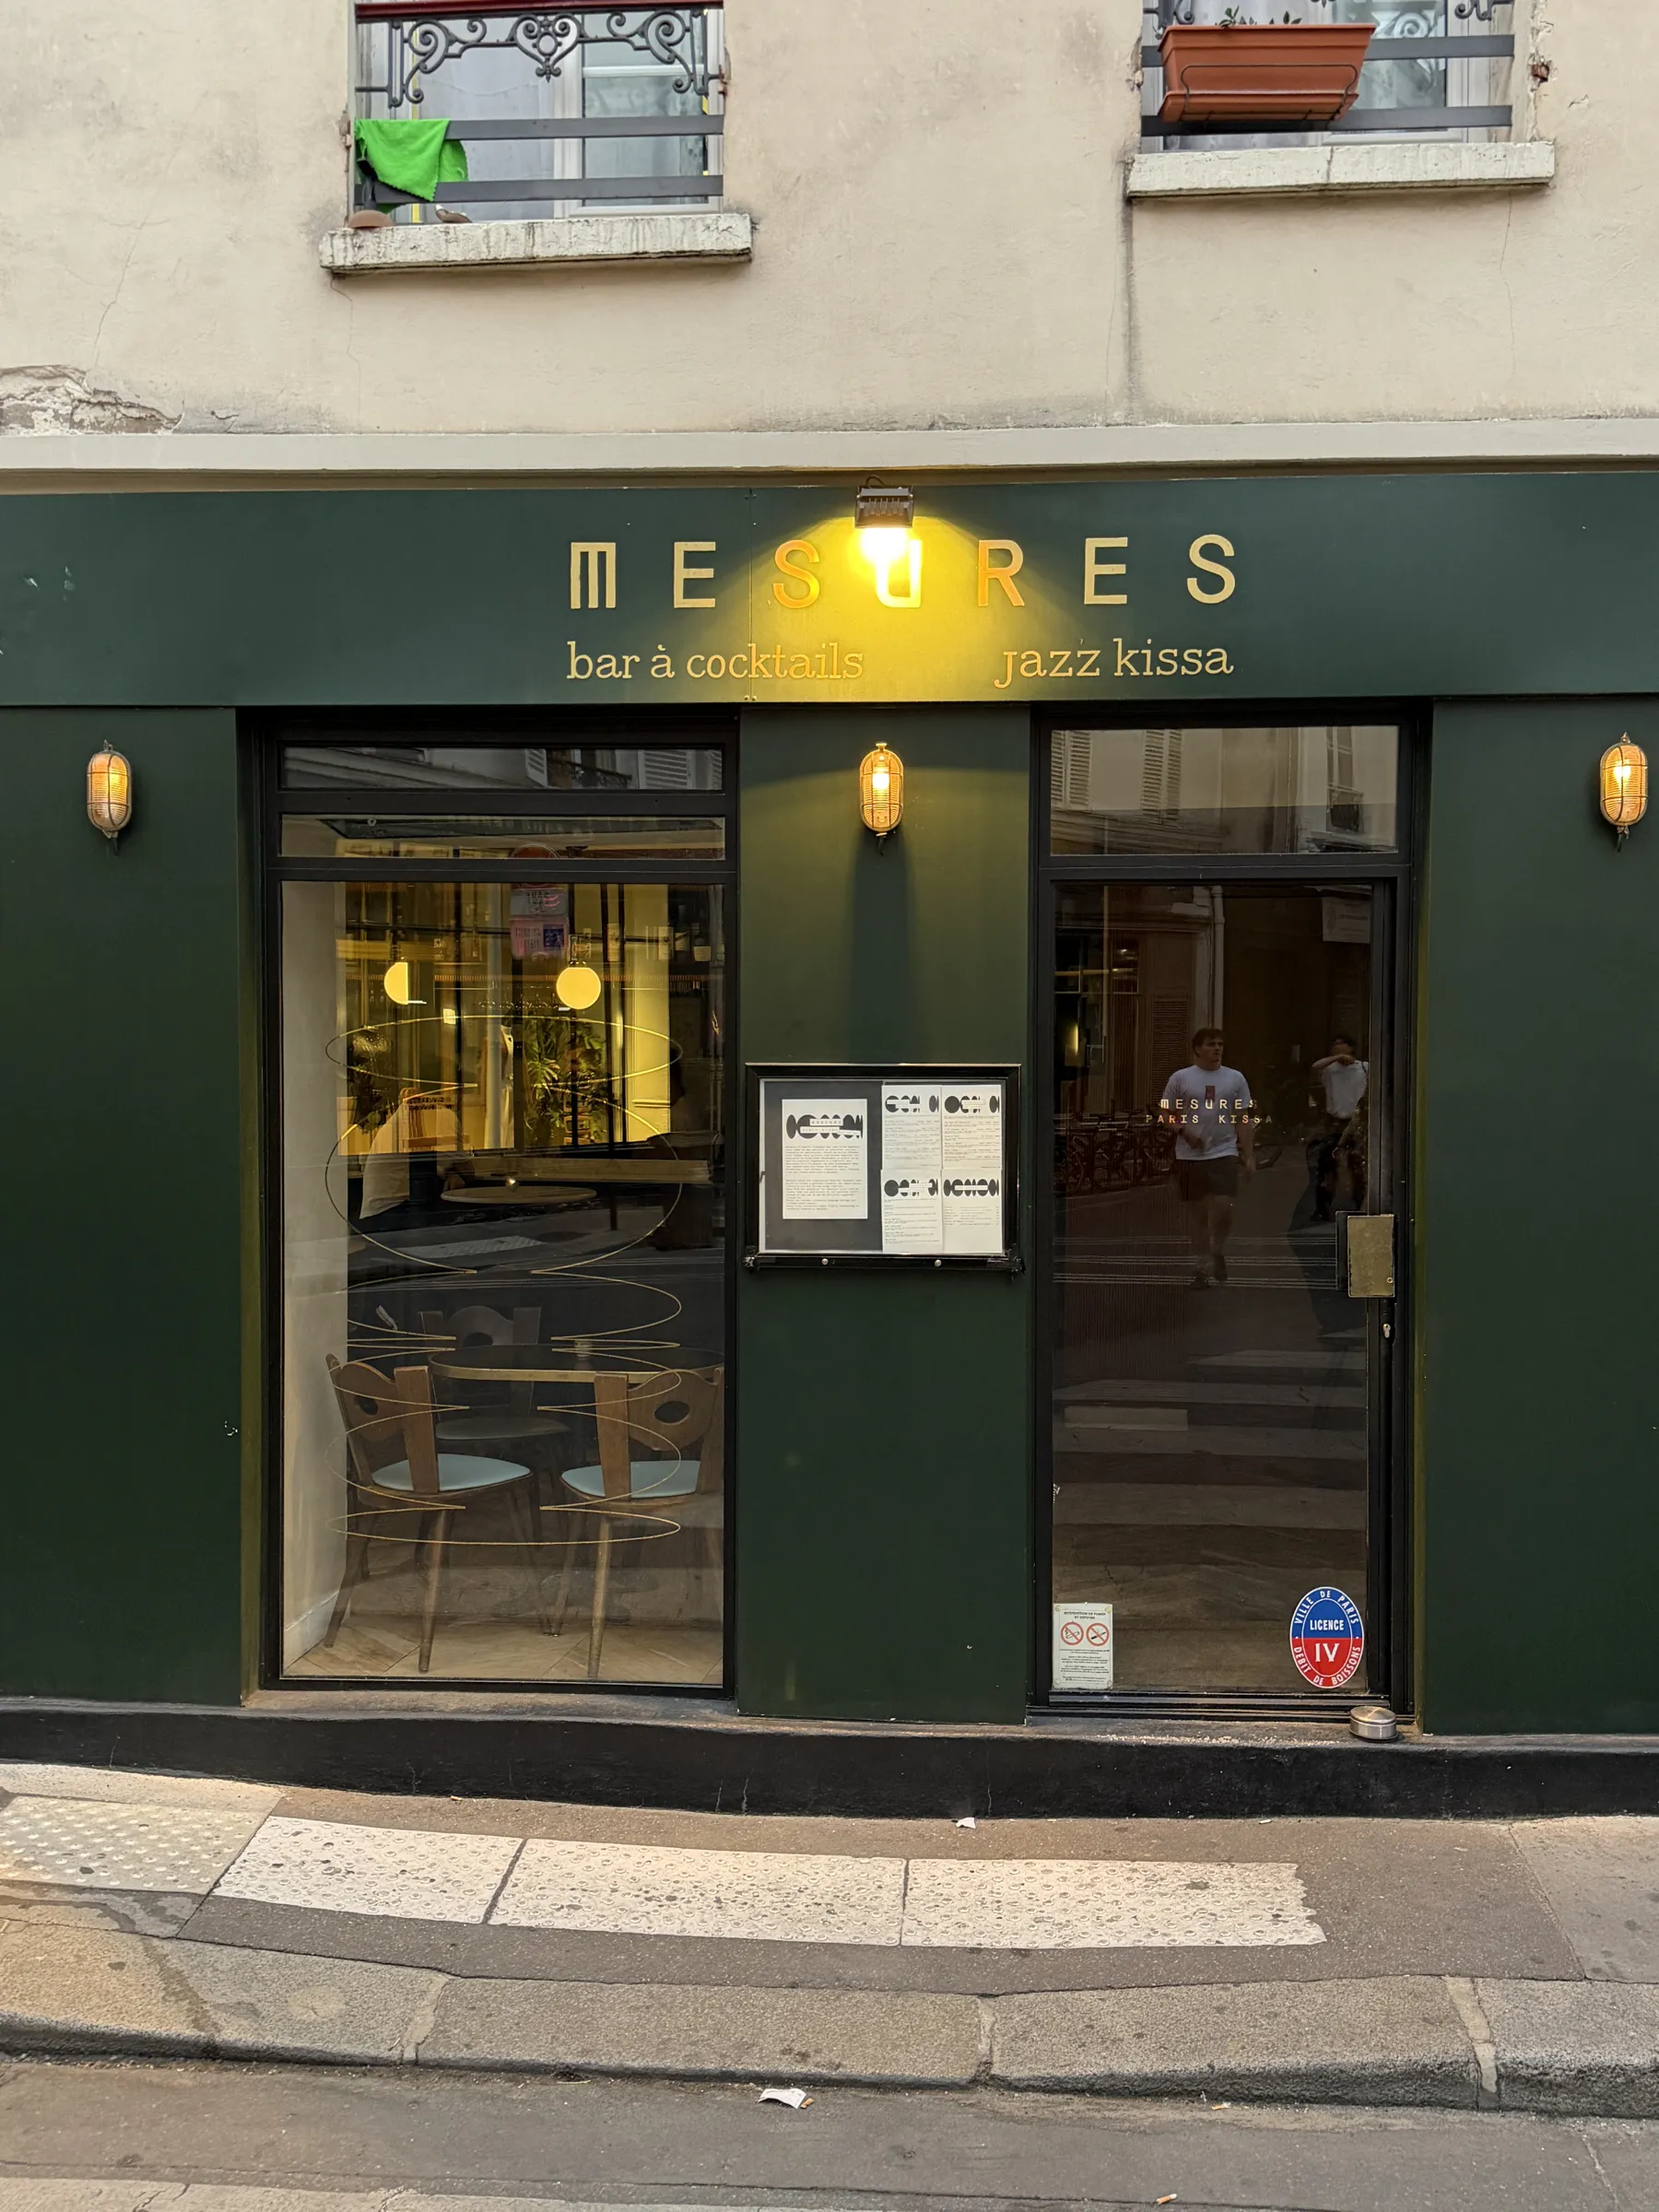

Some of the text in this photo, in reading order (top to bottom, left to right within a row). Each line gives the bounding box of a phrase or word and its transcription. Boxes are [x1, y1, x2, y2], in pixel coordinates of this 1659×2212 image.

[569, 534, 1237, 609] MESURES
[567, 641, 865, 679] bar à cocktails
[994, 638, 1235, 688] jazz kissa
[1146, 1114, 1274, 1124] PARIS KISSA
[1159, 1099, 1258, 1110] MESURES
[1294, 1590, 1359, 1625] VILLE DE PARIS
[1310, 1619, 1345, 1631] LICENCE
[1293, 1646, 1361, 1686] DEBIT DE BOISSONS
[1315, 1642, 1340, 1663] IV
